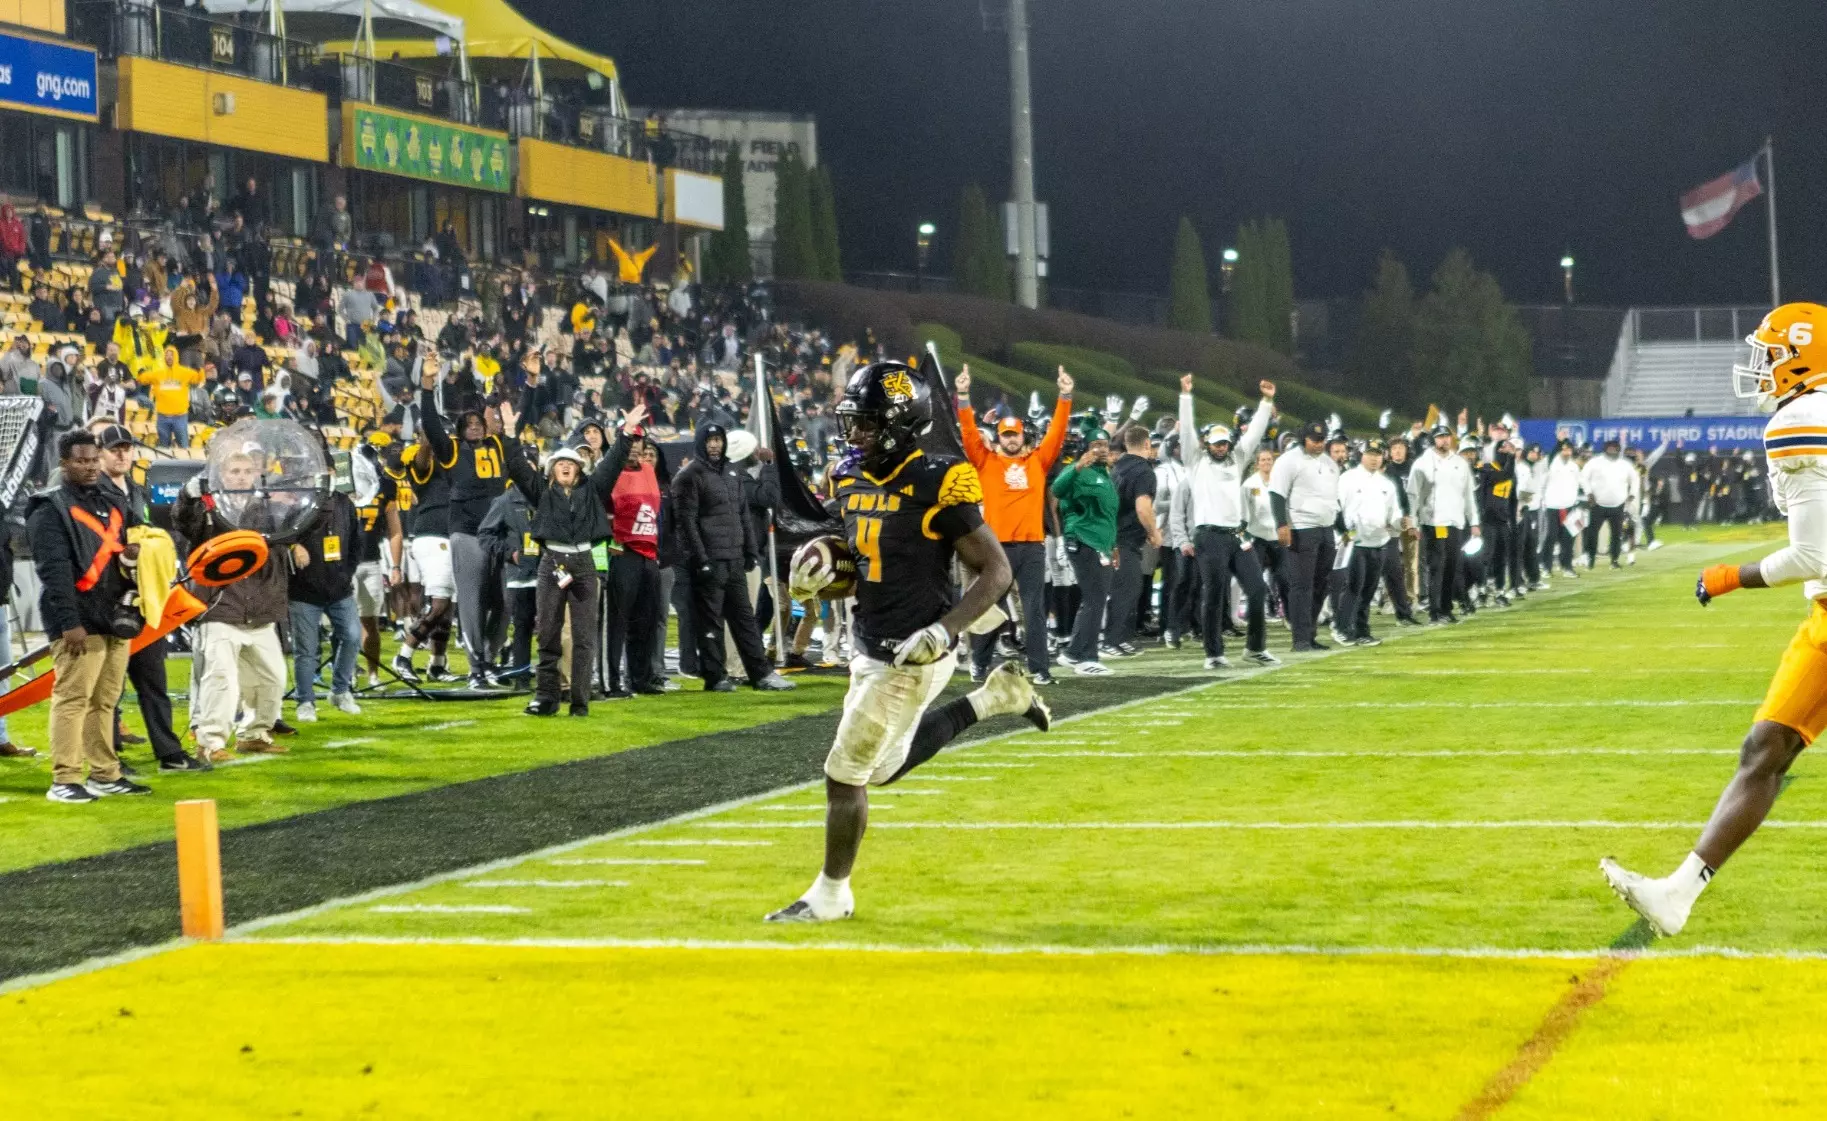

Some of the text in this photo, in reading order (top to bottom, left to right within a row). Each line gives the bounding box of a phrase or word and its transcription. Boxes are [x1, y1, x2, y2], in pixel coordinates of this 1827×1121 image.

[212, 33, 234, 58] 104
[36, 71, 90, 101] gng.com
[1788, 322, 1813, 346] 6
[1593, 424, 1766, 442] FIFTH THIRD STADIU
[474, 446, 501, 479] 61
[847, 493, 901, 512] OWLS
[856, 515, 883, 583] 4
